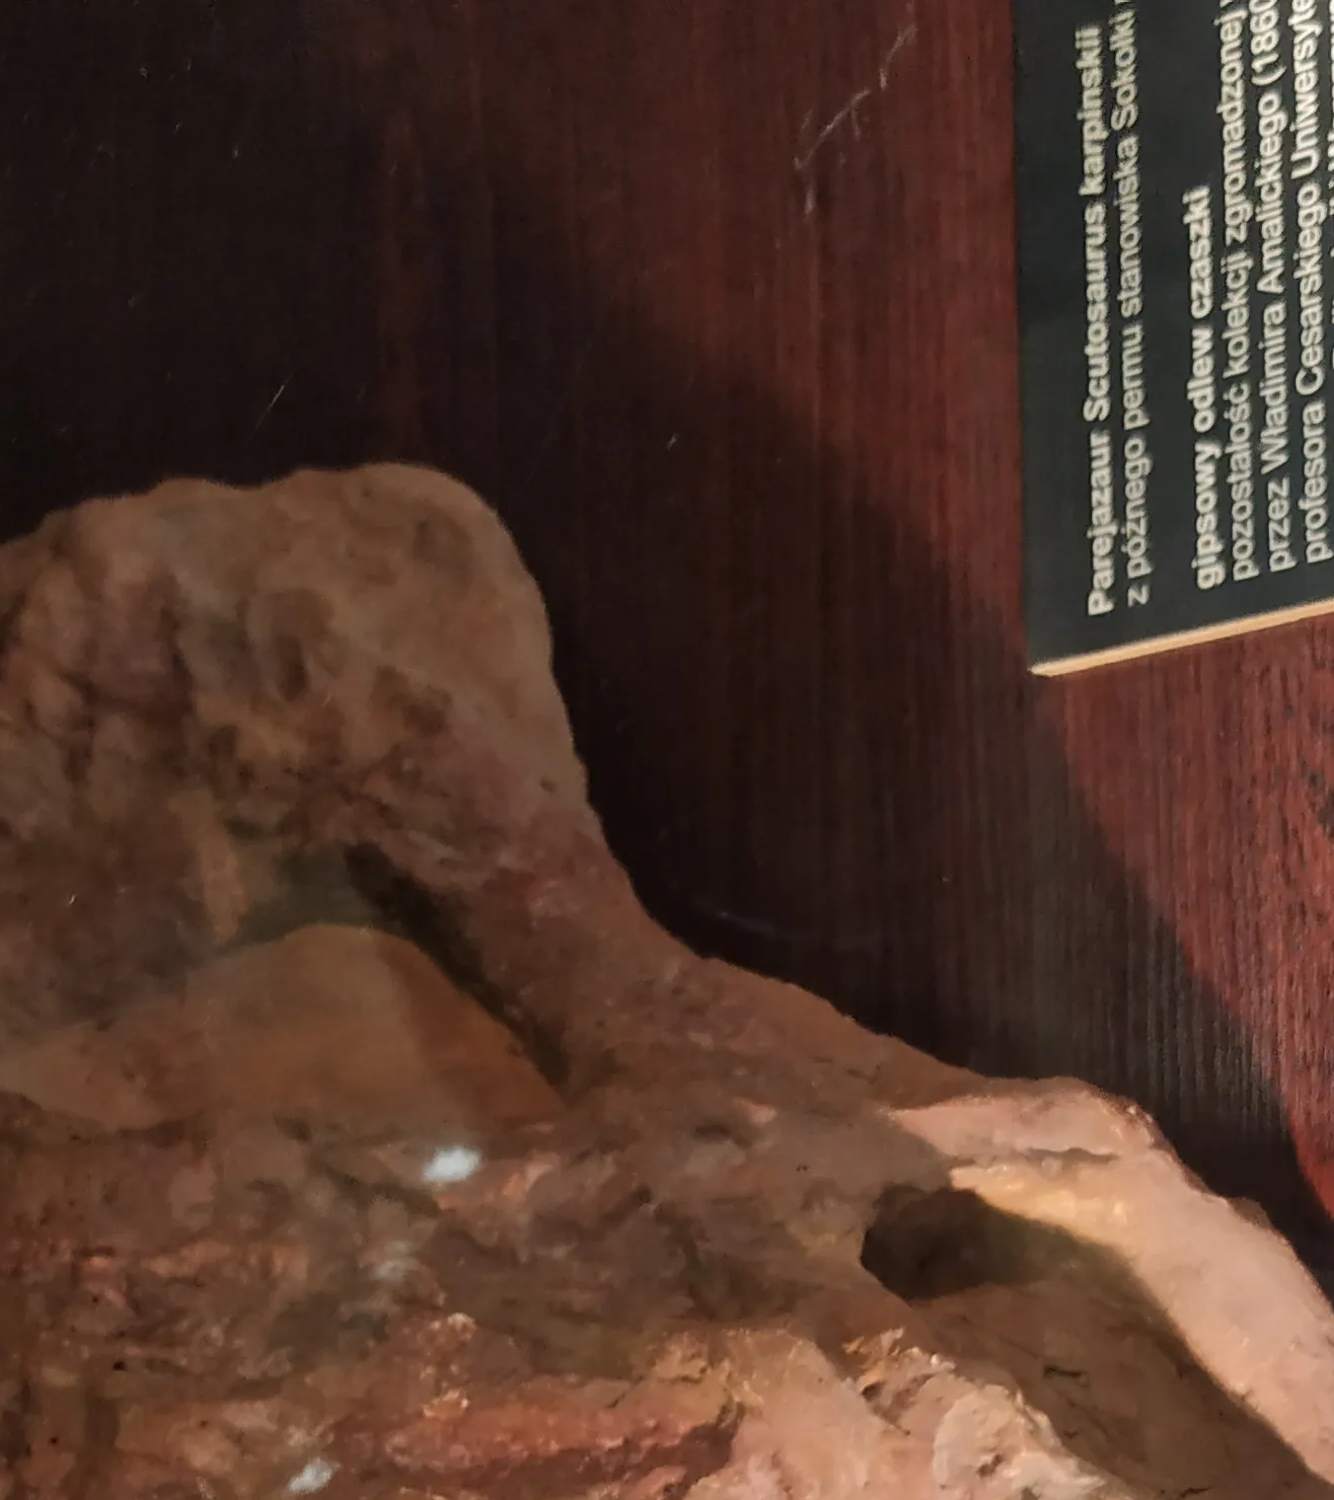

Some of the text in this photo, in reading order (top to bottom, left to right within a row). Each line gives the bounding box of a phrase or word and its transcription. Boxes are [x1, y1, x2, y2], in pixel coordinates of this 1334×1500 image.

[1112, 135, 1143, 318] stanowiska
[1254, 90, 1288, 295] Amalickiego
[1075, 27, 1119, 616] Parejazaur Scutosaurus karpinskii
[1121, 323, 1150, 430] permu
[1214, 9, 1260, 581] pozostałość kolekcji zgromadzonej
[1292, 181, 1327, 396] Cesarskiego
[1182, 185, 1226, 590] gipsowy odlew czaszki
[1256, 302, 1289, 475] Władimira
[1266, 477, 1298, 572] przez
[1298, 402, 1334, 564] profesora
[1127, 584, 1149, 607] z
